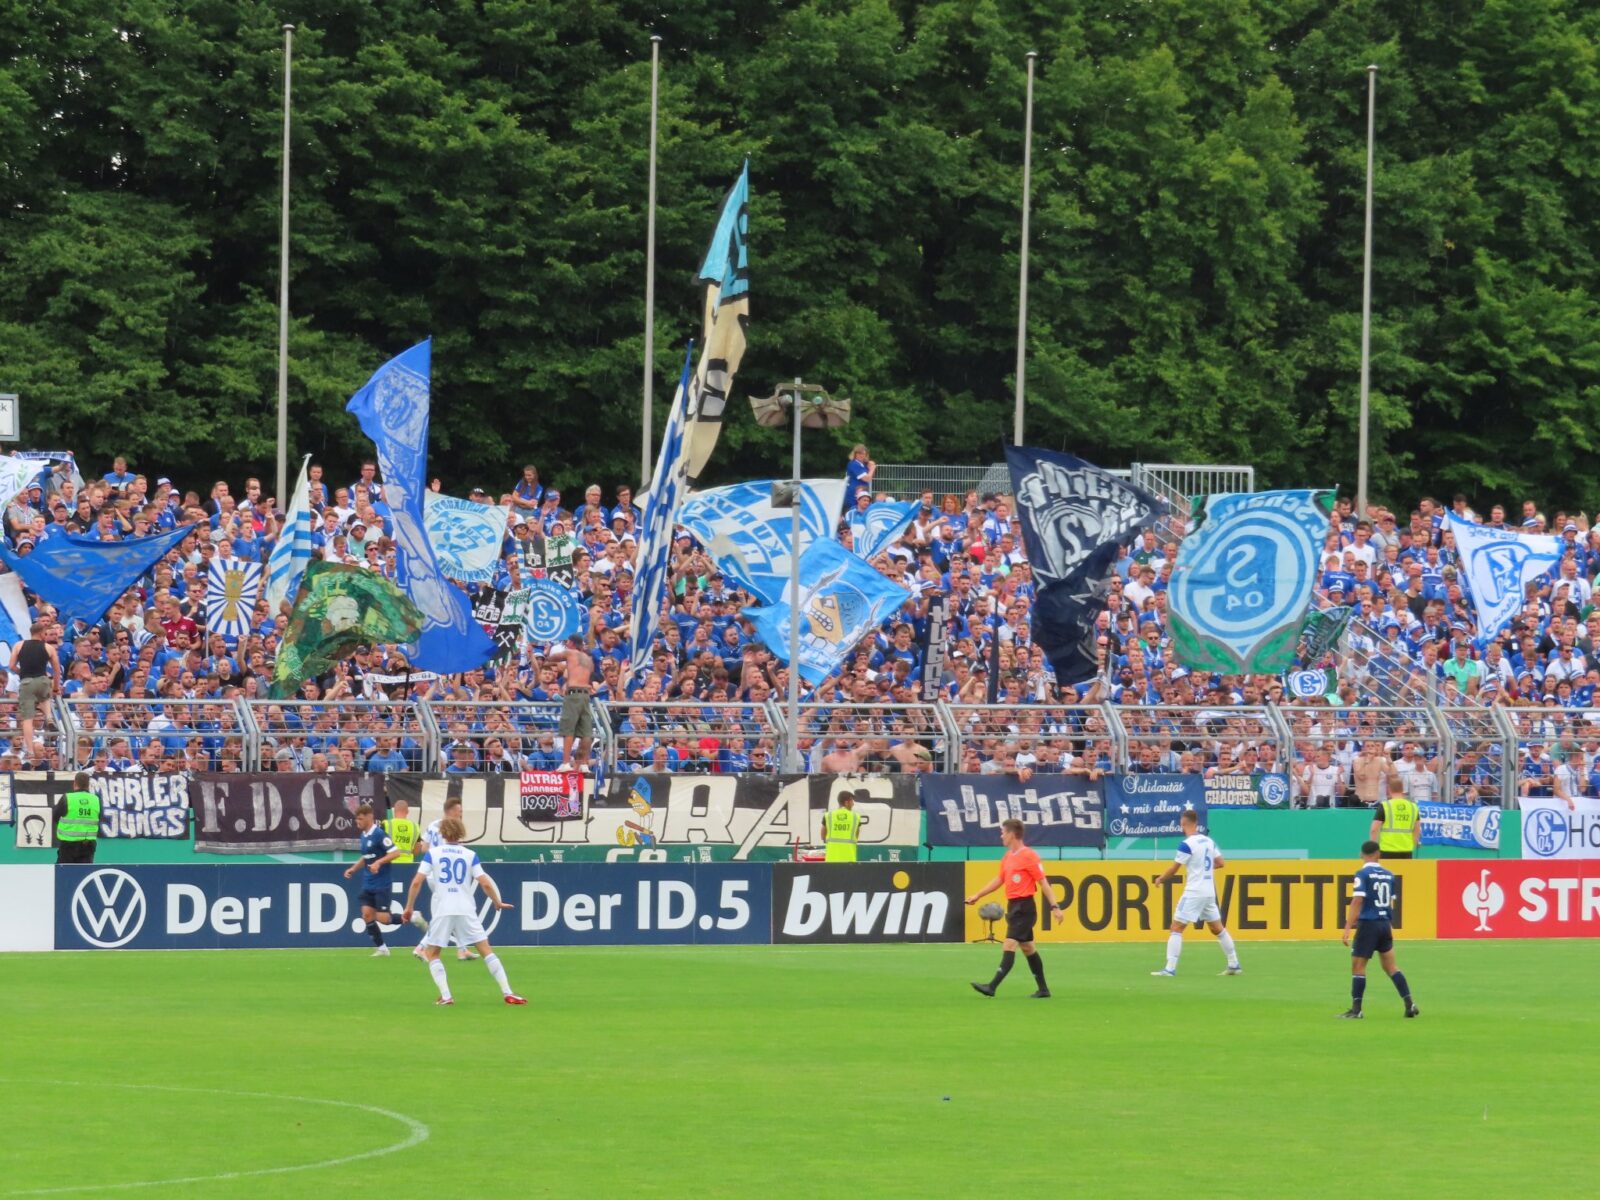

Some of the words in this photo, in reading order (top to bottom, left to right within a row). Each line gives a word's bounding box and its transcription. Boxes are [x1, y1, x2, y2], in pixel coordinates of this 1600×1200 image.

[89, 774, 189, 811] MARLER
[1123, 775, 1184, 794] Solidarität
[521, 795, 557, 810] 1994
[1133, 803, 1151, 815] mit
[1153, 799, 1181, 813] allen
[101, 808, 185, 838] JUNGS
[439, 857, 467, 884] 30
[166, 883, 271, 934] Der
[521, 881, 621, 931] Der
[638, 879, 750, 931] ID.5
[783, 871, 949, 935] bwin
